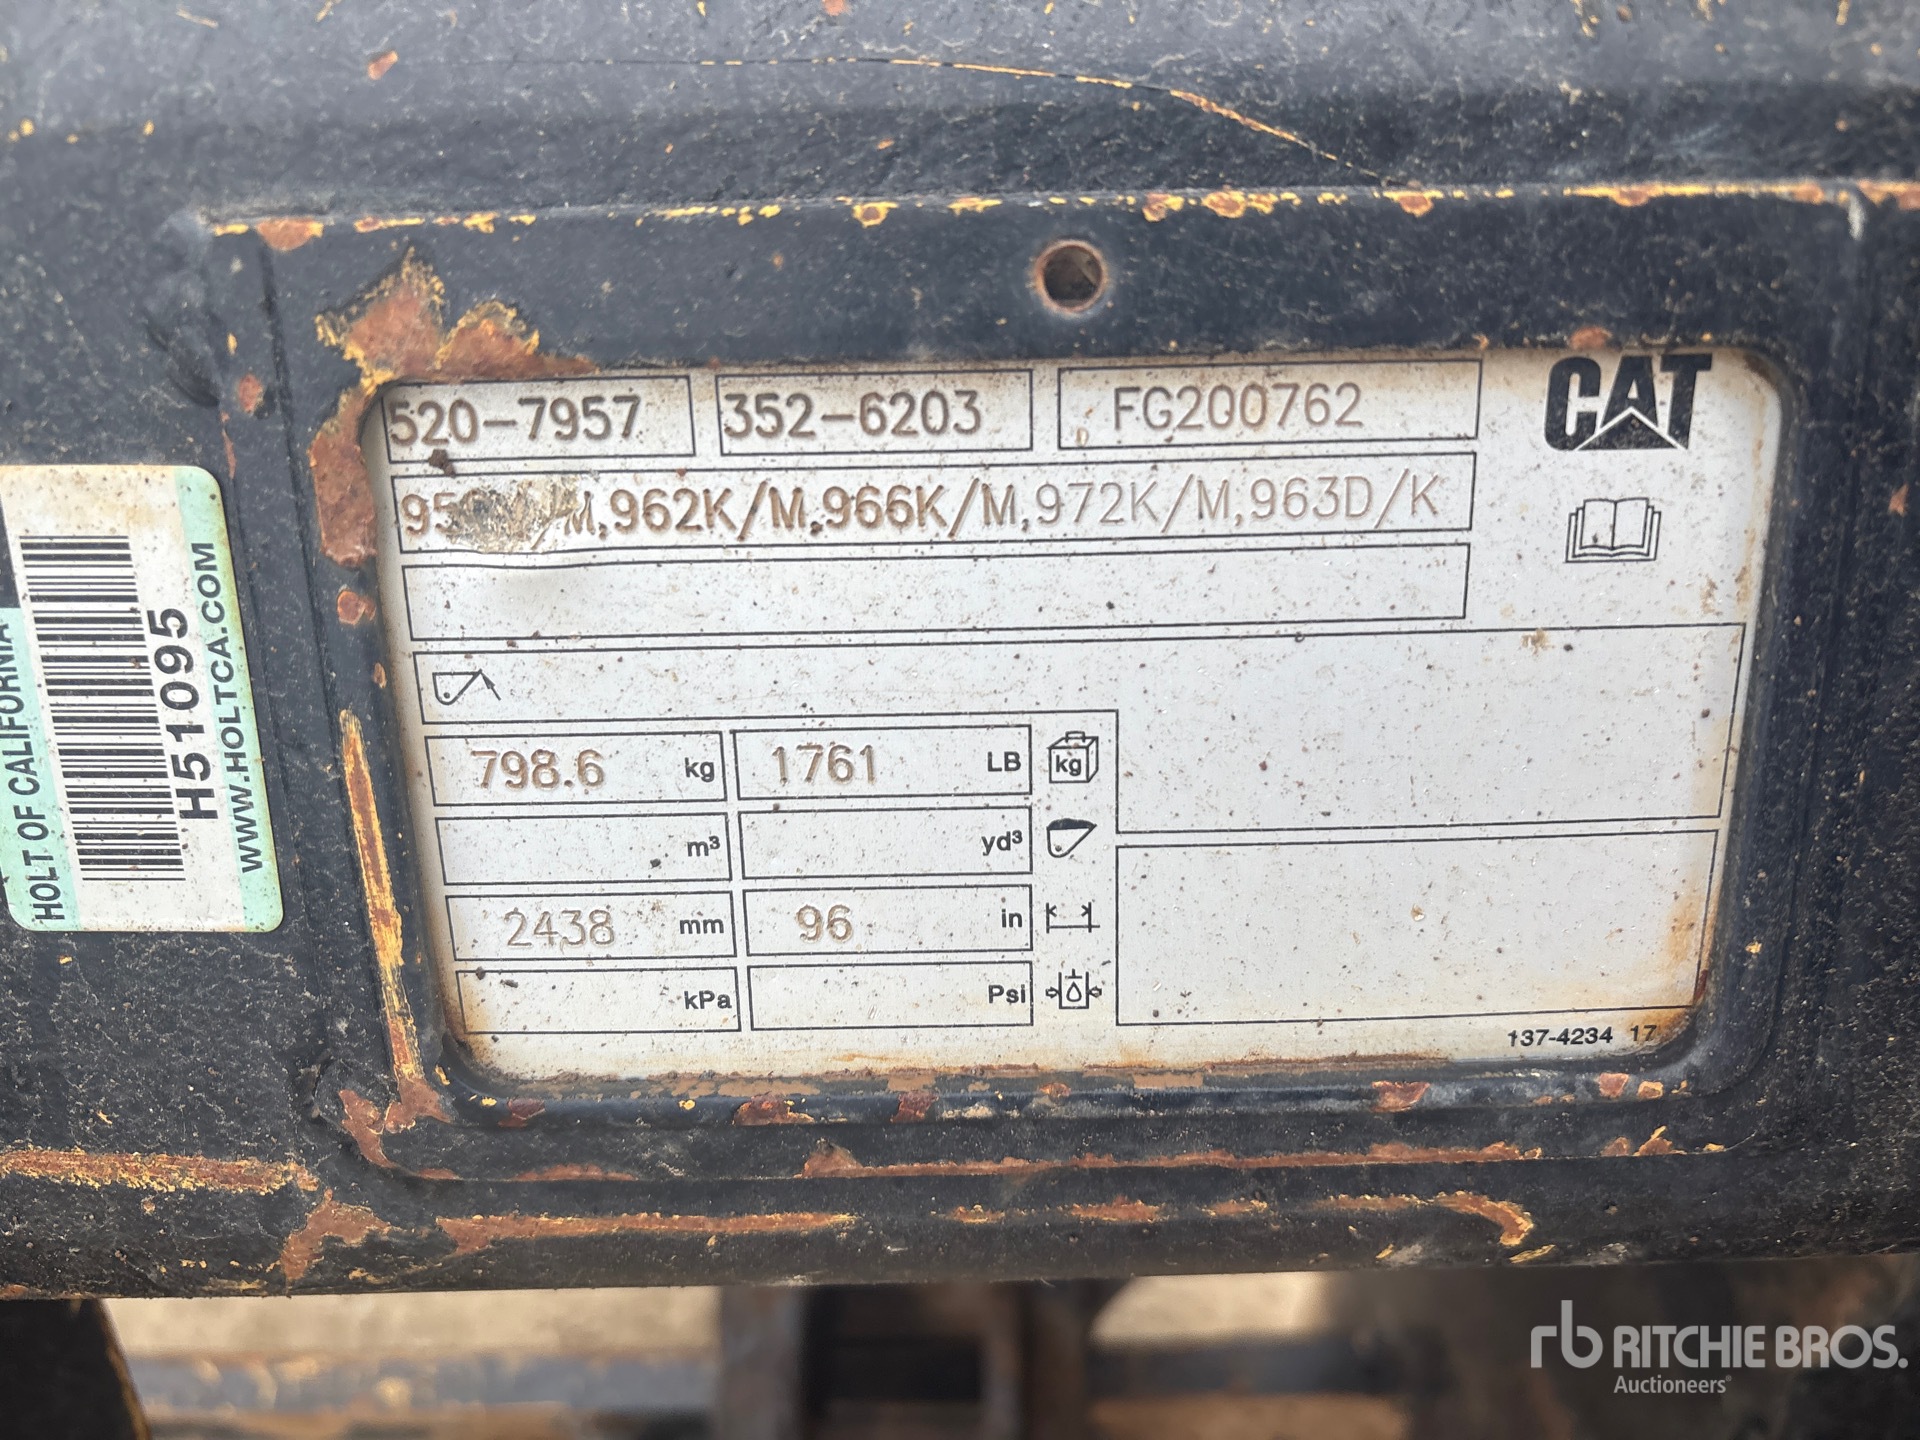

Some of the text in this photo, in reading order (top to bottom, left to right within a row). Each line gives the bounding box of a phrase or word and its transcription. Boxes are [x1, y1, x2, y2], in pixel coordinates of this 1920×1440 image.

[388, 395, 641, 446] 520-7957
[724, 389, 982, 440] 352-6203
[1112, 382, 1364, 431] FG200762
[1544, 353, 1712, 451] CAT
[147, 607, 219, 820] H51095
[191, 542, 263, 873] WWW.HOLTCA.COM
[470, 748, 605, 789] 798.6
[685, 757, 715, 783] kg
[771, 744, 876, 785] 1761
[987, 751, 1022, 773] LB
[1056, 754, 1082, 777] kg
[13, 804, 49, 842] OF
[23, 849, 65, 921] HOLT
[503, 908, 616, 950] 2438
[679, 917, 725, 935] mm
[795, 904, 853, 943] 96
[1001, 908, 1023, 928] in
[684, 990, 732, 1010] kPa
[988, 984, 1026, 1004] Psi
[1507, 1025, 1656, 1047] 137-4234 17
